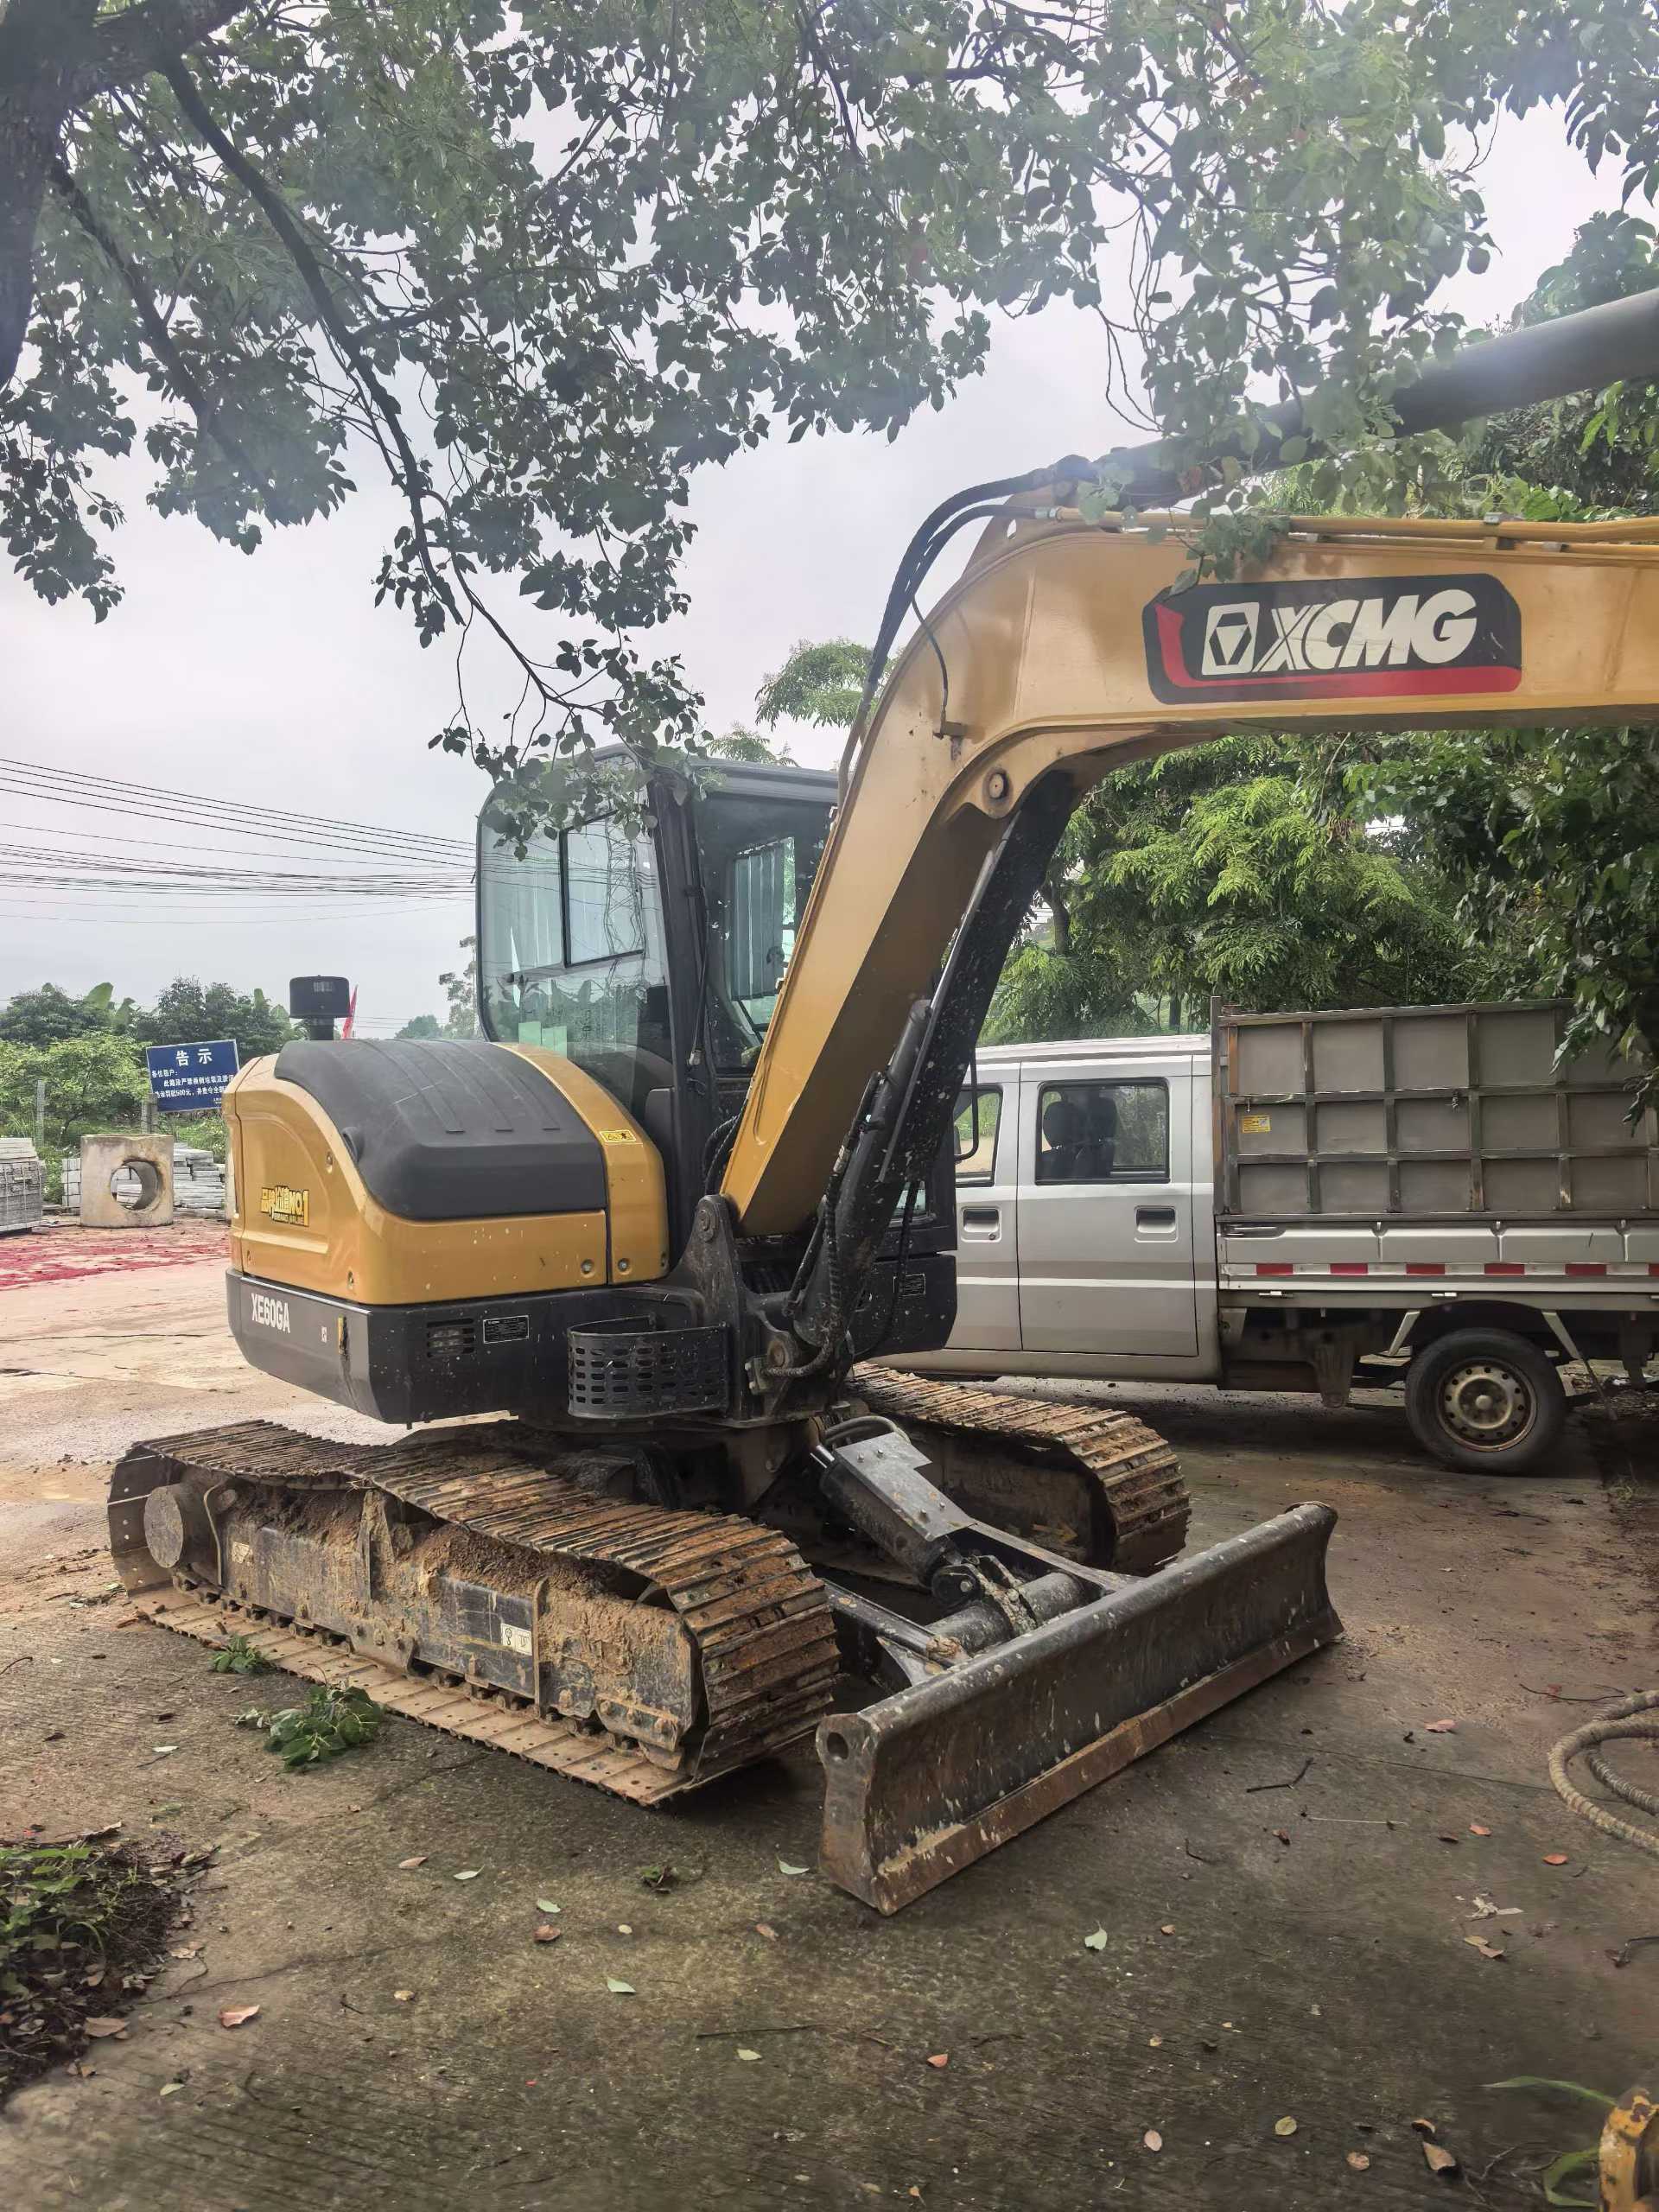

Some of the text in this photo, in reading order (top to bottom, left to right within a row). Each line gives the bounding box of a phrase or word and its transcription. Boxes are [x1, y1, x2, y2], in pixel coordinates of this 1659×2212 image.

[1253, 588, 1477, 672] XCMG
[175, 1048, 213, 1067] 告示
[251, 1292, 291, 1333] XE60GA
